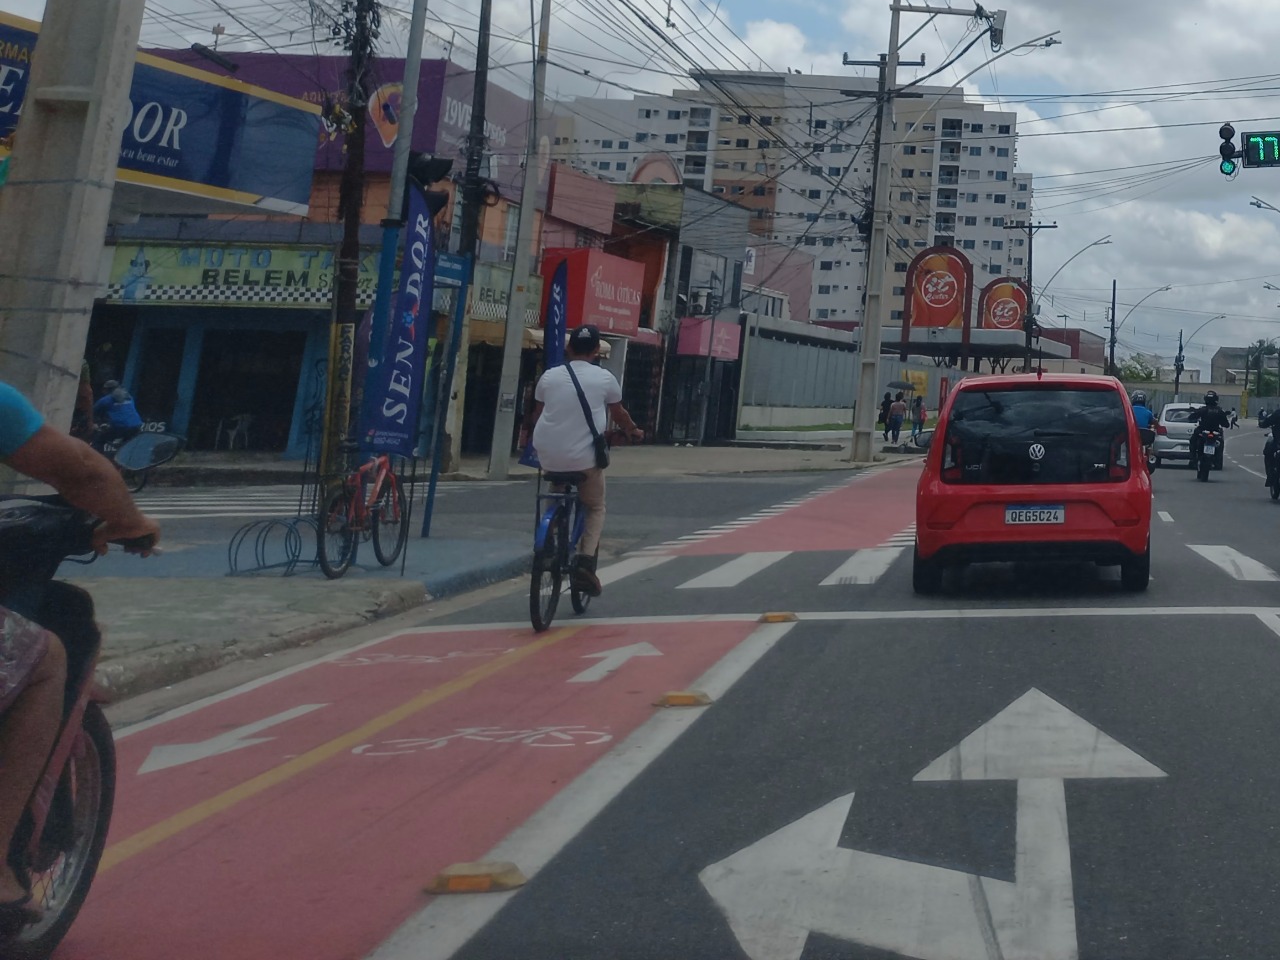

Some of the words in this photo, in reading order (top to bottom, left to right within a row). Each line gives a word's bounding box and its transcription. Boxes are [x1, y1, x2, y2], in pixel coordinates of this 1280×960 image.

[137, 148, 156, 163] bem
[157, 153, 179, 167] estar
[1250, 136, 1279, 161] 77
[178, 248, 272, 269] MOTO
[202, 268, 310, 287] BELEM
[1010, 510, 1059, 523] QEG5C24
